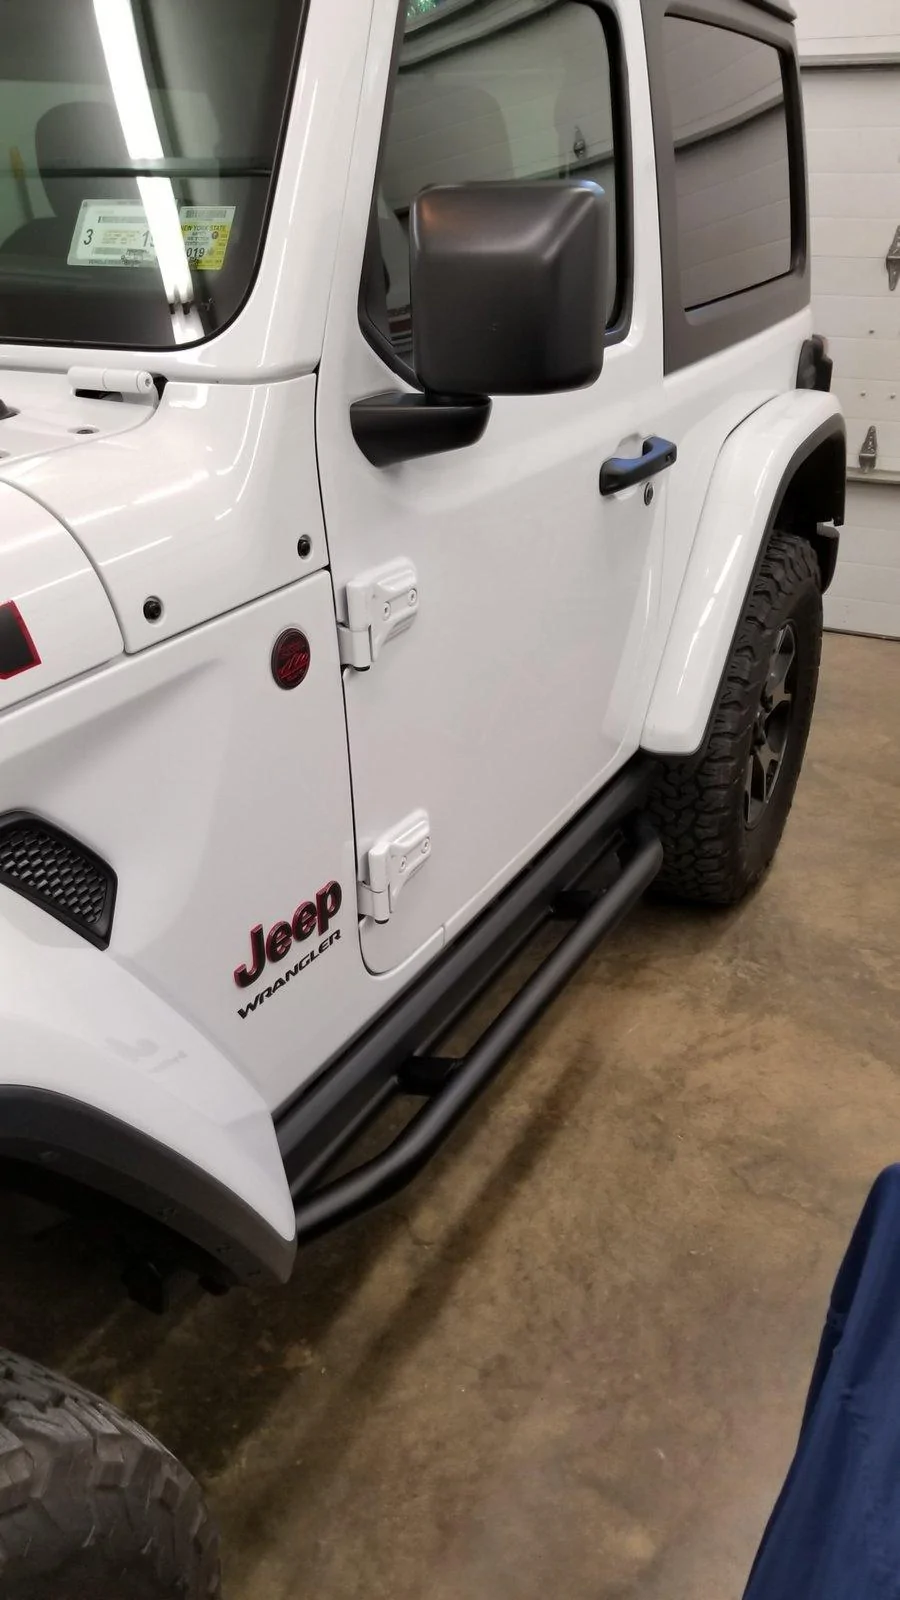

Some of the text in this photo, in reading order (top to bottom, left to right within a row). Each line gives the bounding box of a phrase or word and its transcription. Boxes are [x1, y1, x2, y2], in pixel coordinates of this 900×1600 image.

[83, 228, 94, 246] 3
[233, 880, 343, 988] Jeep
[237, 929, 342, 1019] WRANGLER
